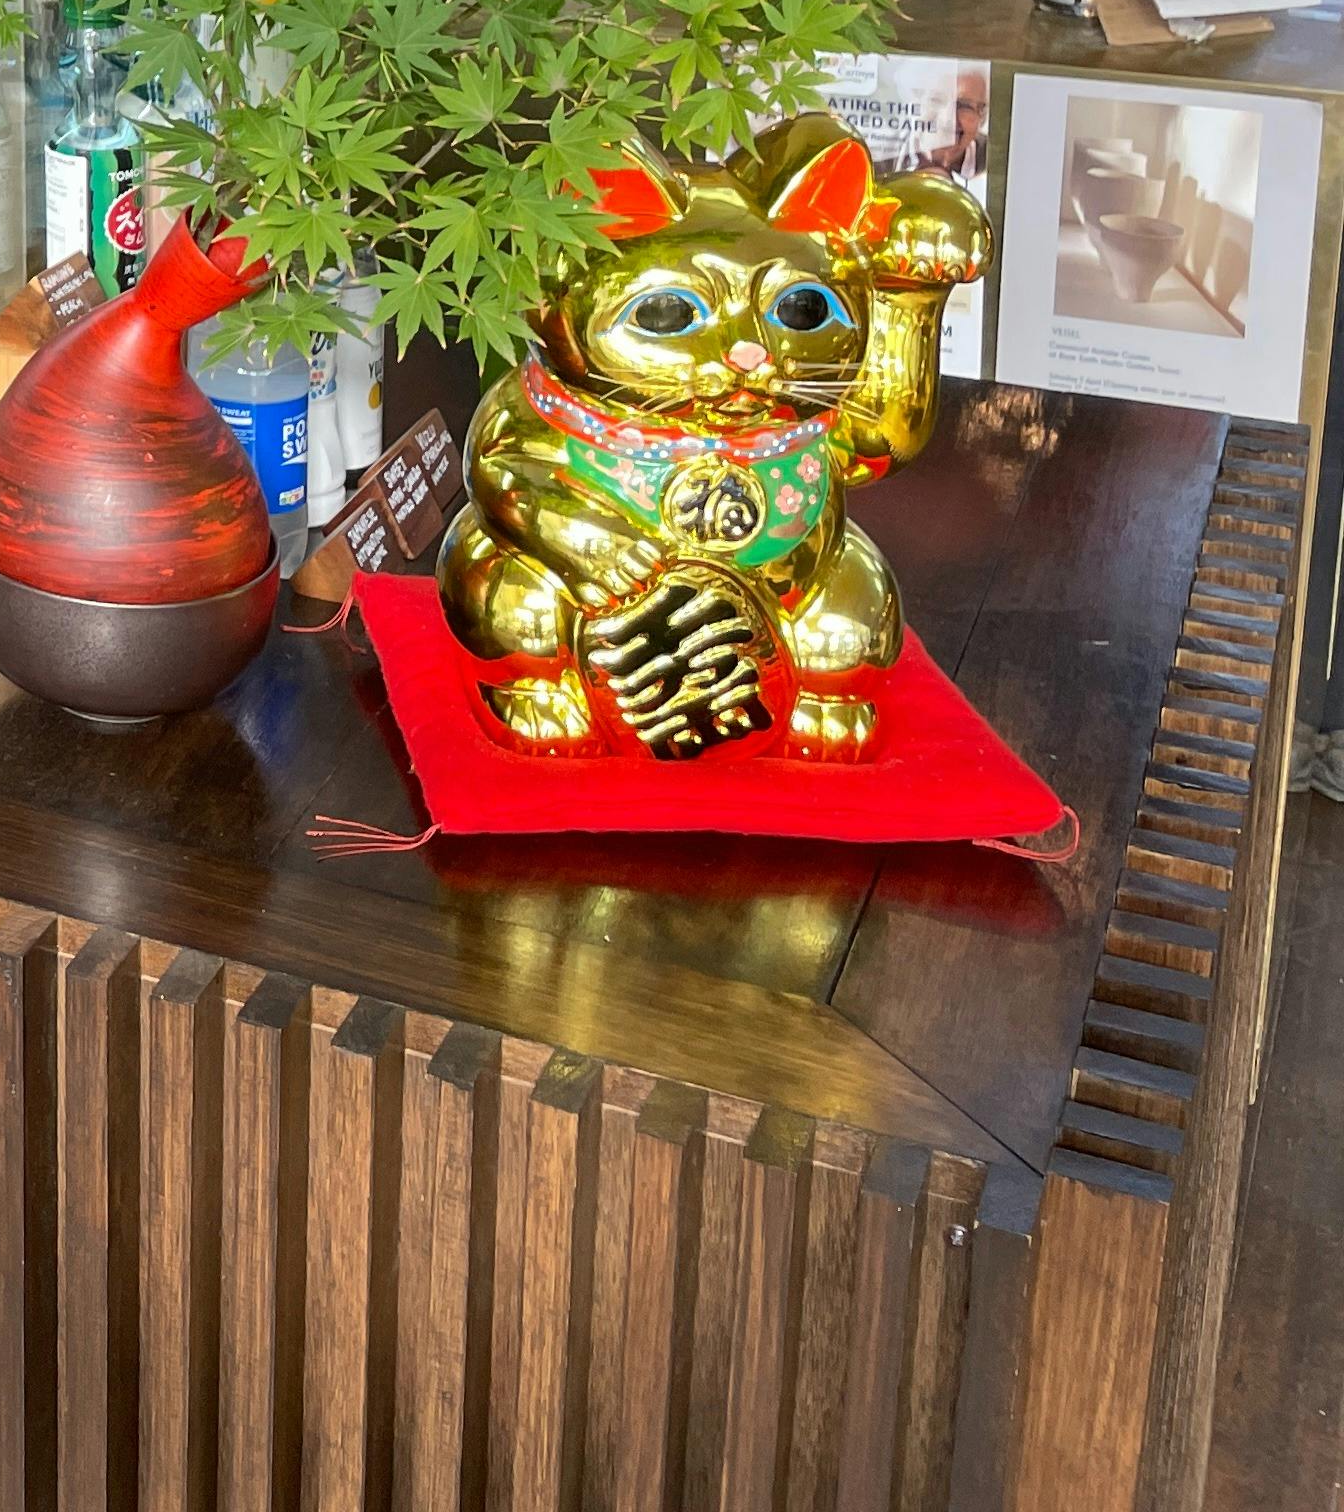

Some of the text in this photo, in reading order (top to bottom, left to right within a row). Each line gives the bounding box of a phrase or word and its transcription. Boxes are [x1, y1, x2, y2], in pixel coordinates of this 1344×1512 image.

[828, 96, 921, 115] ATING THE
[846, 114, 938, 134] GED CARE
